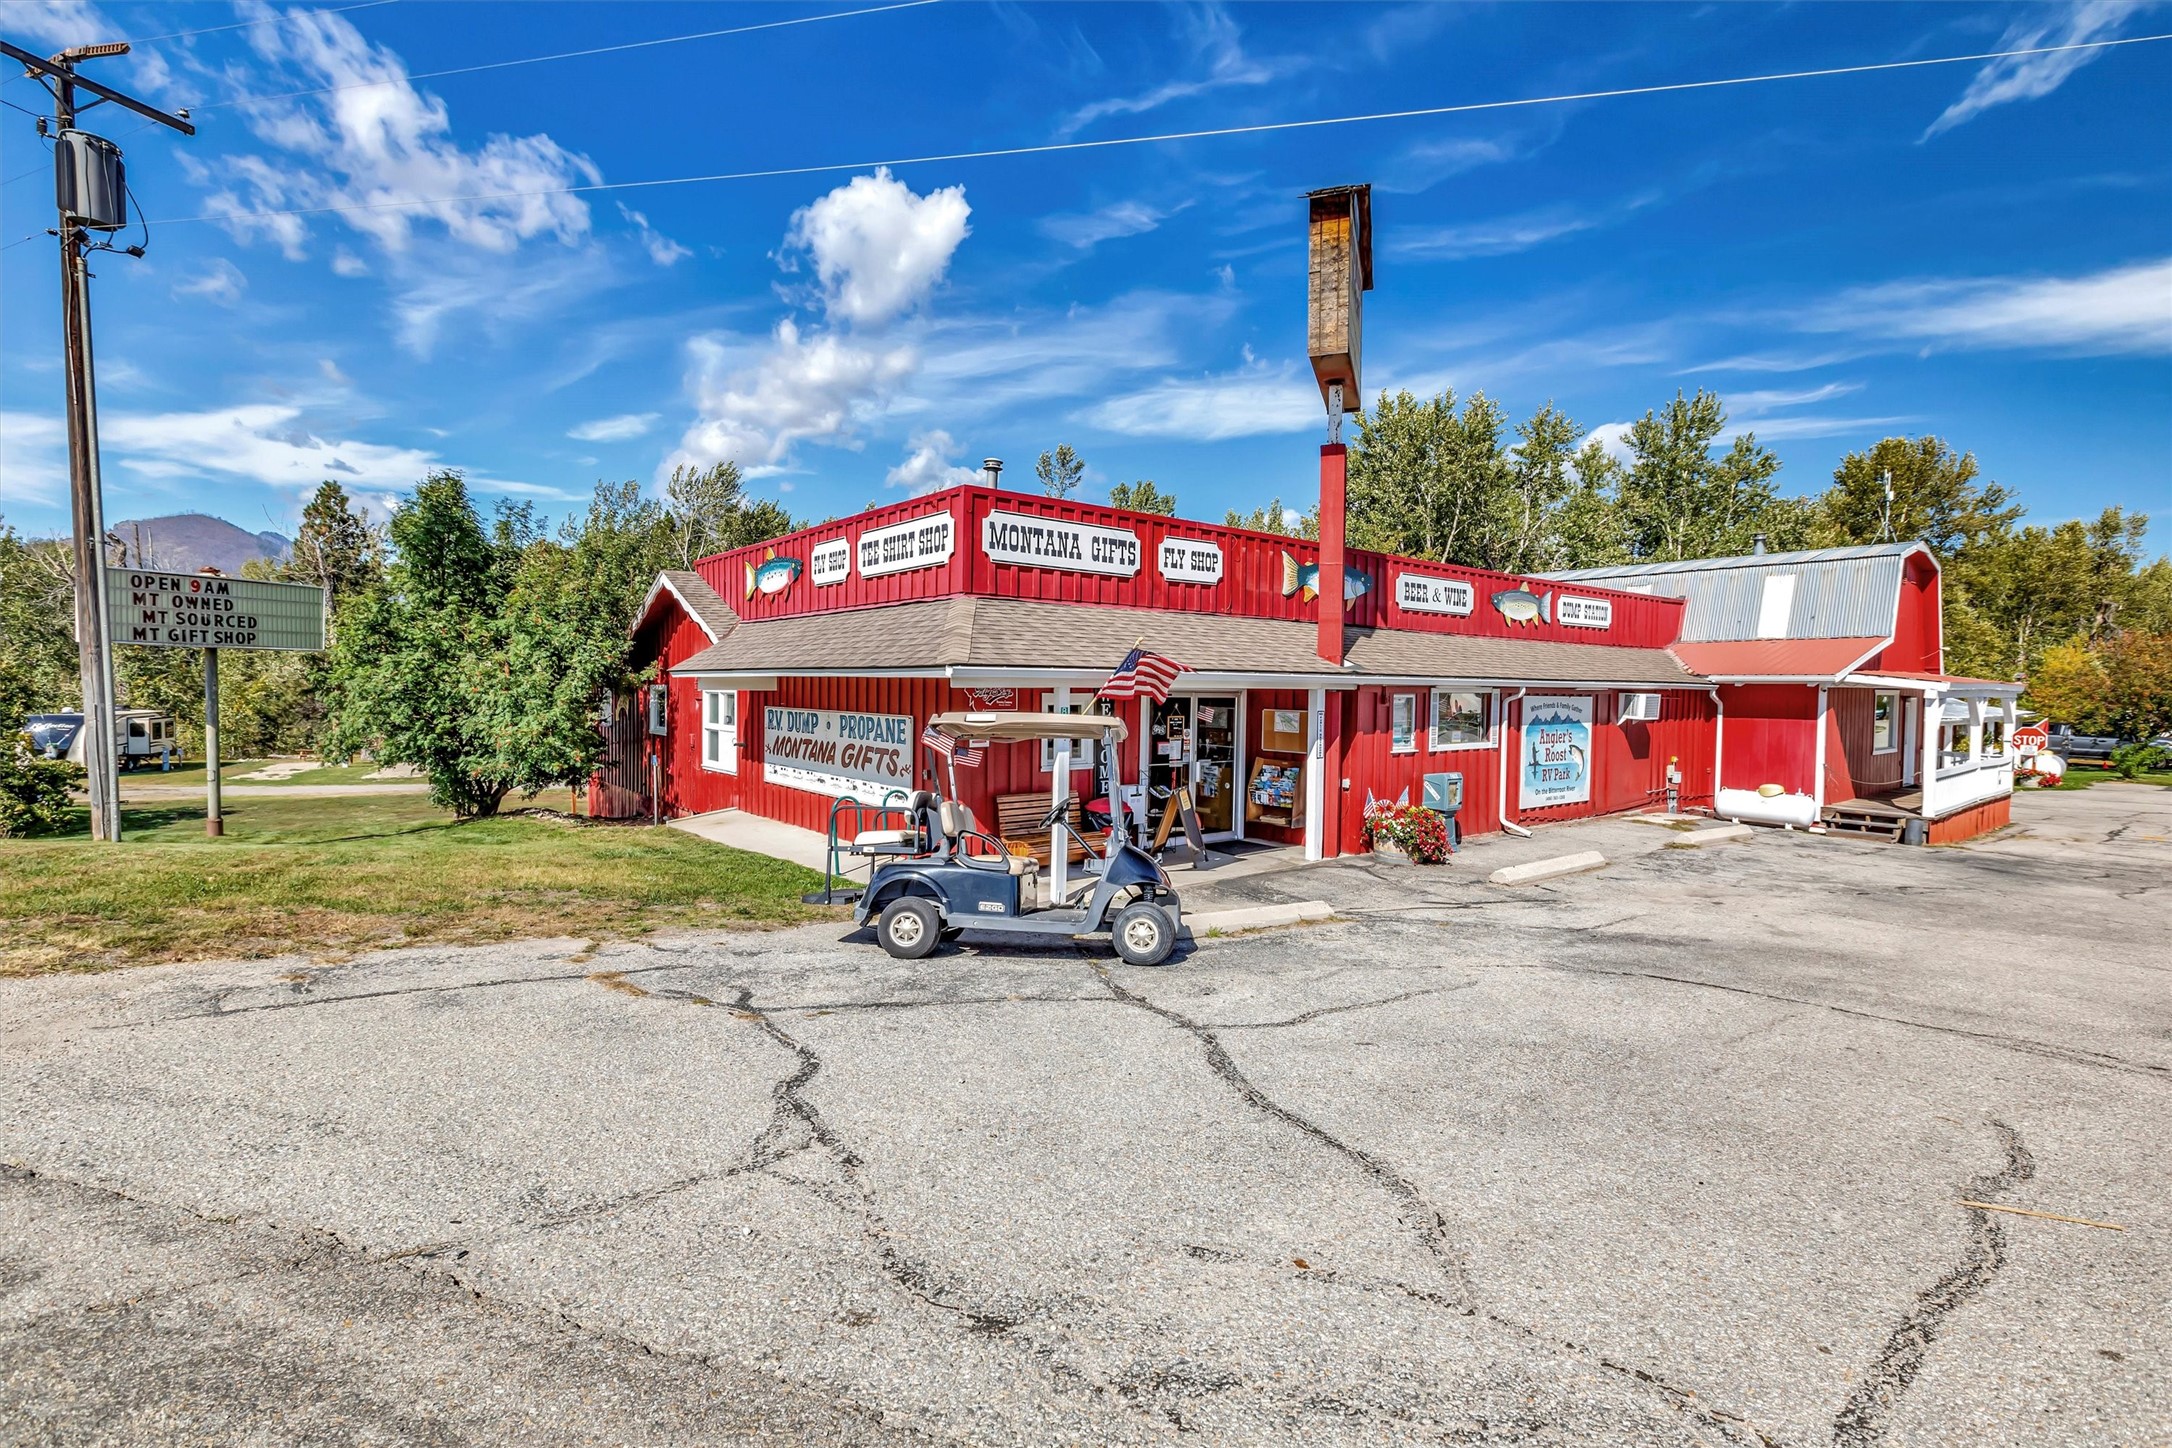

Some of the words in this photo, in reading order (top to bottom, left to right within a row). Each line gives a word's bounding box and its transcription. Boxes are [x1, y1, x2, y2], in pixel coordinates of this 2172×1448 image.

[861, 540, 880, 567] TEE
[883, 531, 915, 563] SHIRT
[919, 523, 949, 556] SHOP
[989, 521, 1082, 559] MONTANA
[1092, 536, 1136, 566] GIFTS
[814, 554, 826, 575] FLY
[828, 549, 847, 572] SHOP
[1163, 548, 1186, 569] FLY
[1190, 551, 1219, 573] SHOP
[130, 575, 181, 592] OPEN
[133, 592, 160, 606] MT
[172, 595, 234, 611] OWNED
[1404, 581, 1429, 603] BEER
[1432, 588, 1441, 603] &
[1444, 587, 1468, 607] WINE
[143, 610, 168, 624] MT
[175, 612, 258, 629] SOURCED
[1562, 601, 1581, 618] DUMP
[1584, 604, 1609, 621] STATION
[133, 627, 160, 641] MT
[168, 628, 209, 643] GIFT
[214, 631, 256, 644] SHOP
[787, 711, 819, 735] DUMP
[839, 715, 907, 745] PROPANE
[1540, 729, 1572, 747] Angler's
[2013, 735, 2046, 746] STOP
[772, 735, 837, 765] MONTANA
[840, 743, 900, 777] GIFTS
[1545, 748, 1566, 762] Roost
[1542, 768, 1553, 782] RV
[1554, 767, 1571, 781] Park
